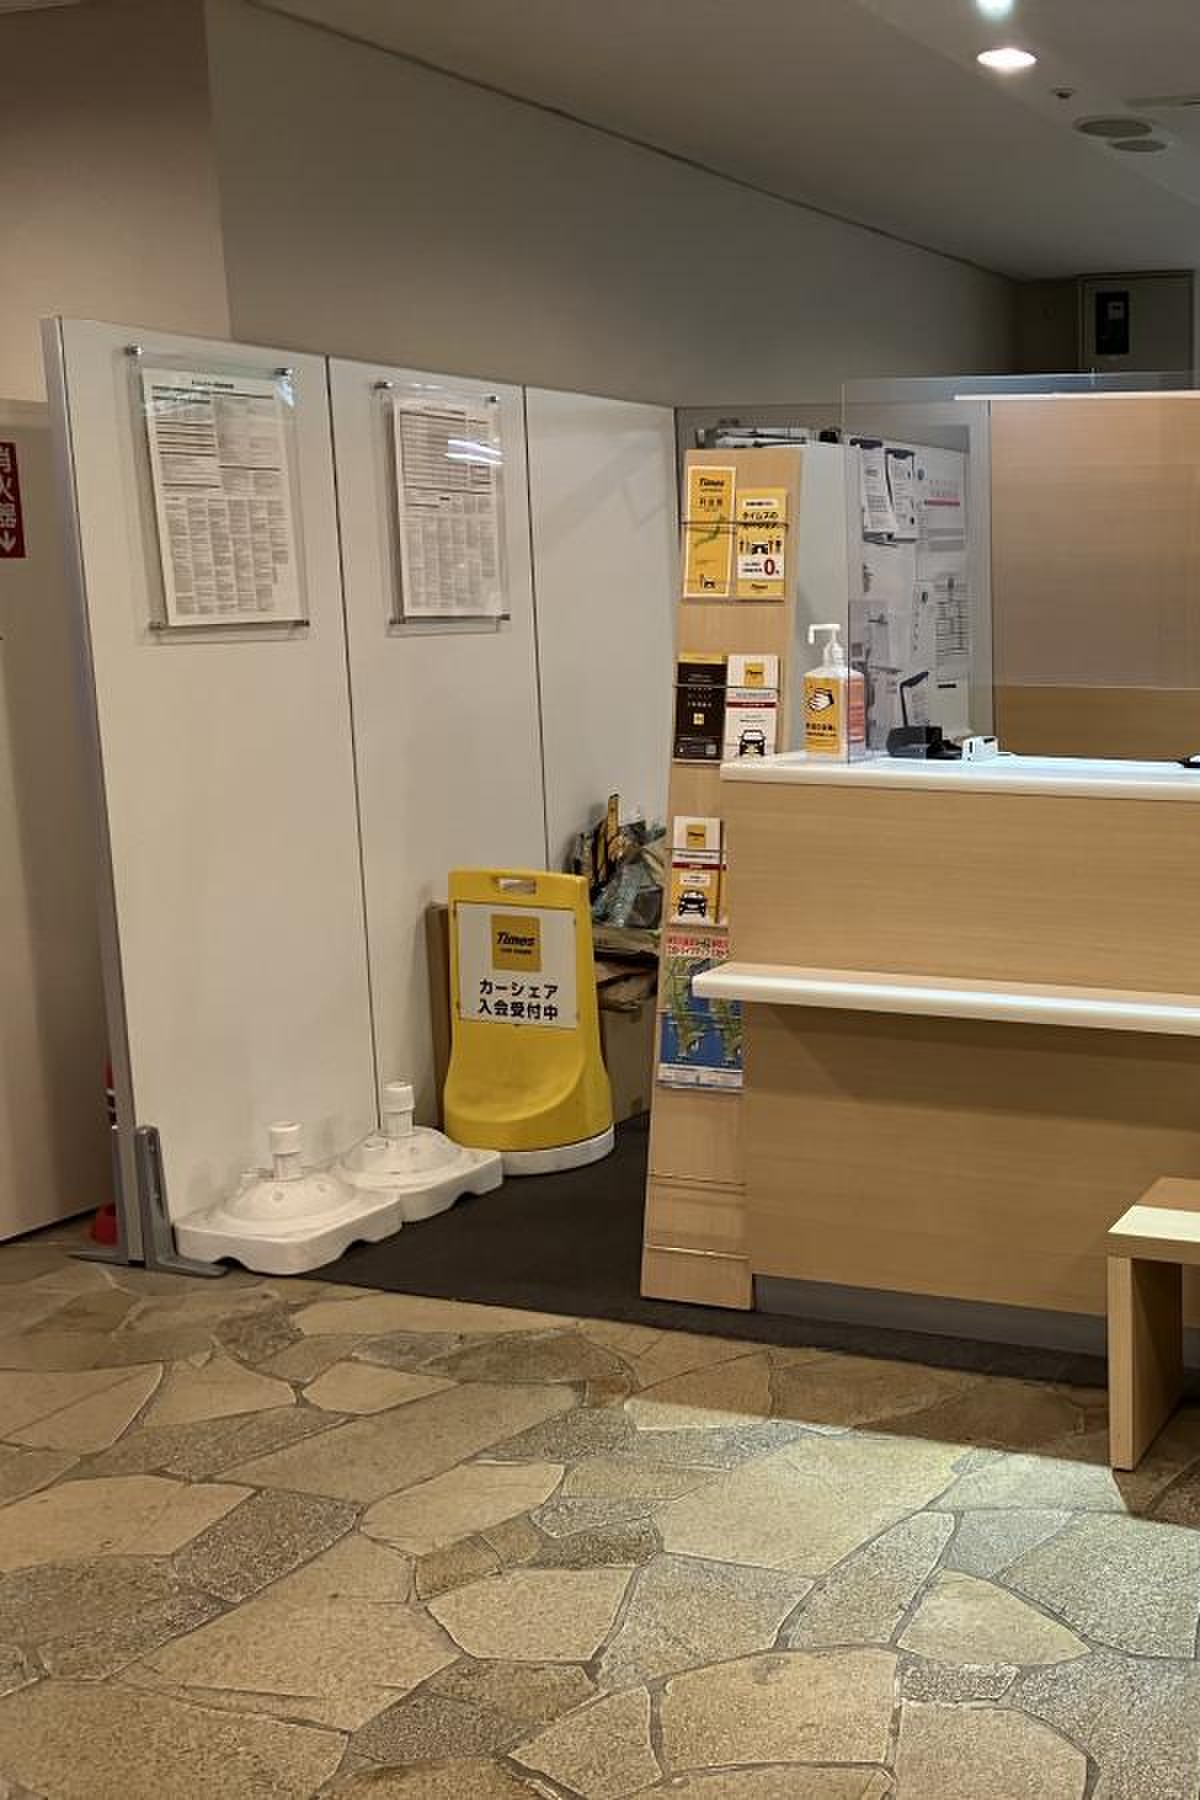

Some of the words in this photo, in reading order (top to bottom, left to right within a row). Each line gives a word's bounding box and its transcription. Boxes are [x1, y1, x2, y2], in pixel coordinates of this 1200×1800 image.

[496, 931, 536, 947] Times
[479, 979, 558, 999] カーシェア
[478, 998, 558, 1021] 入会受付中
